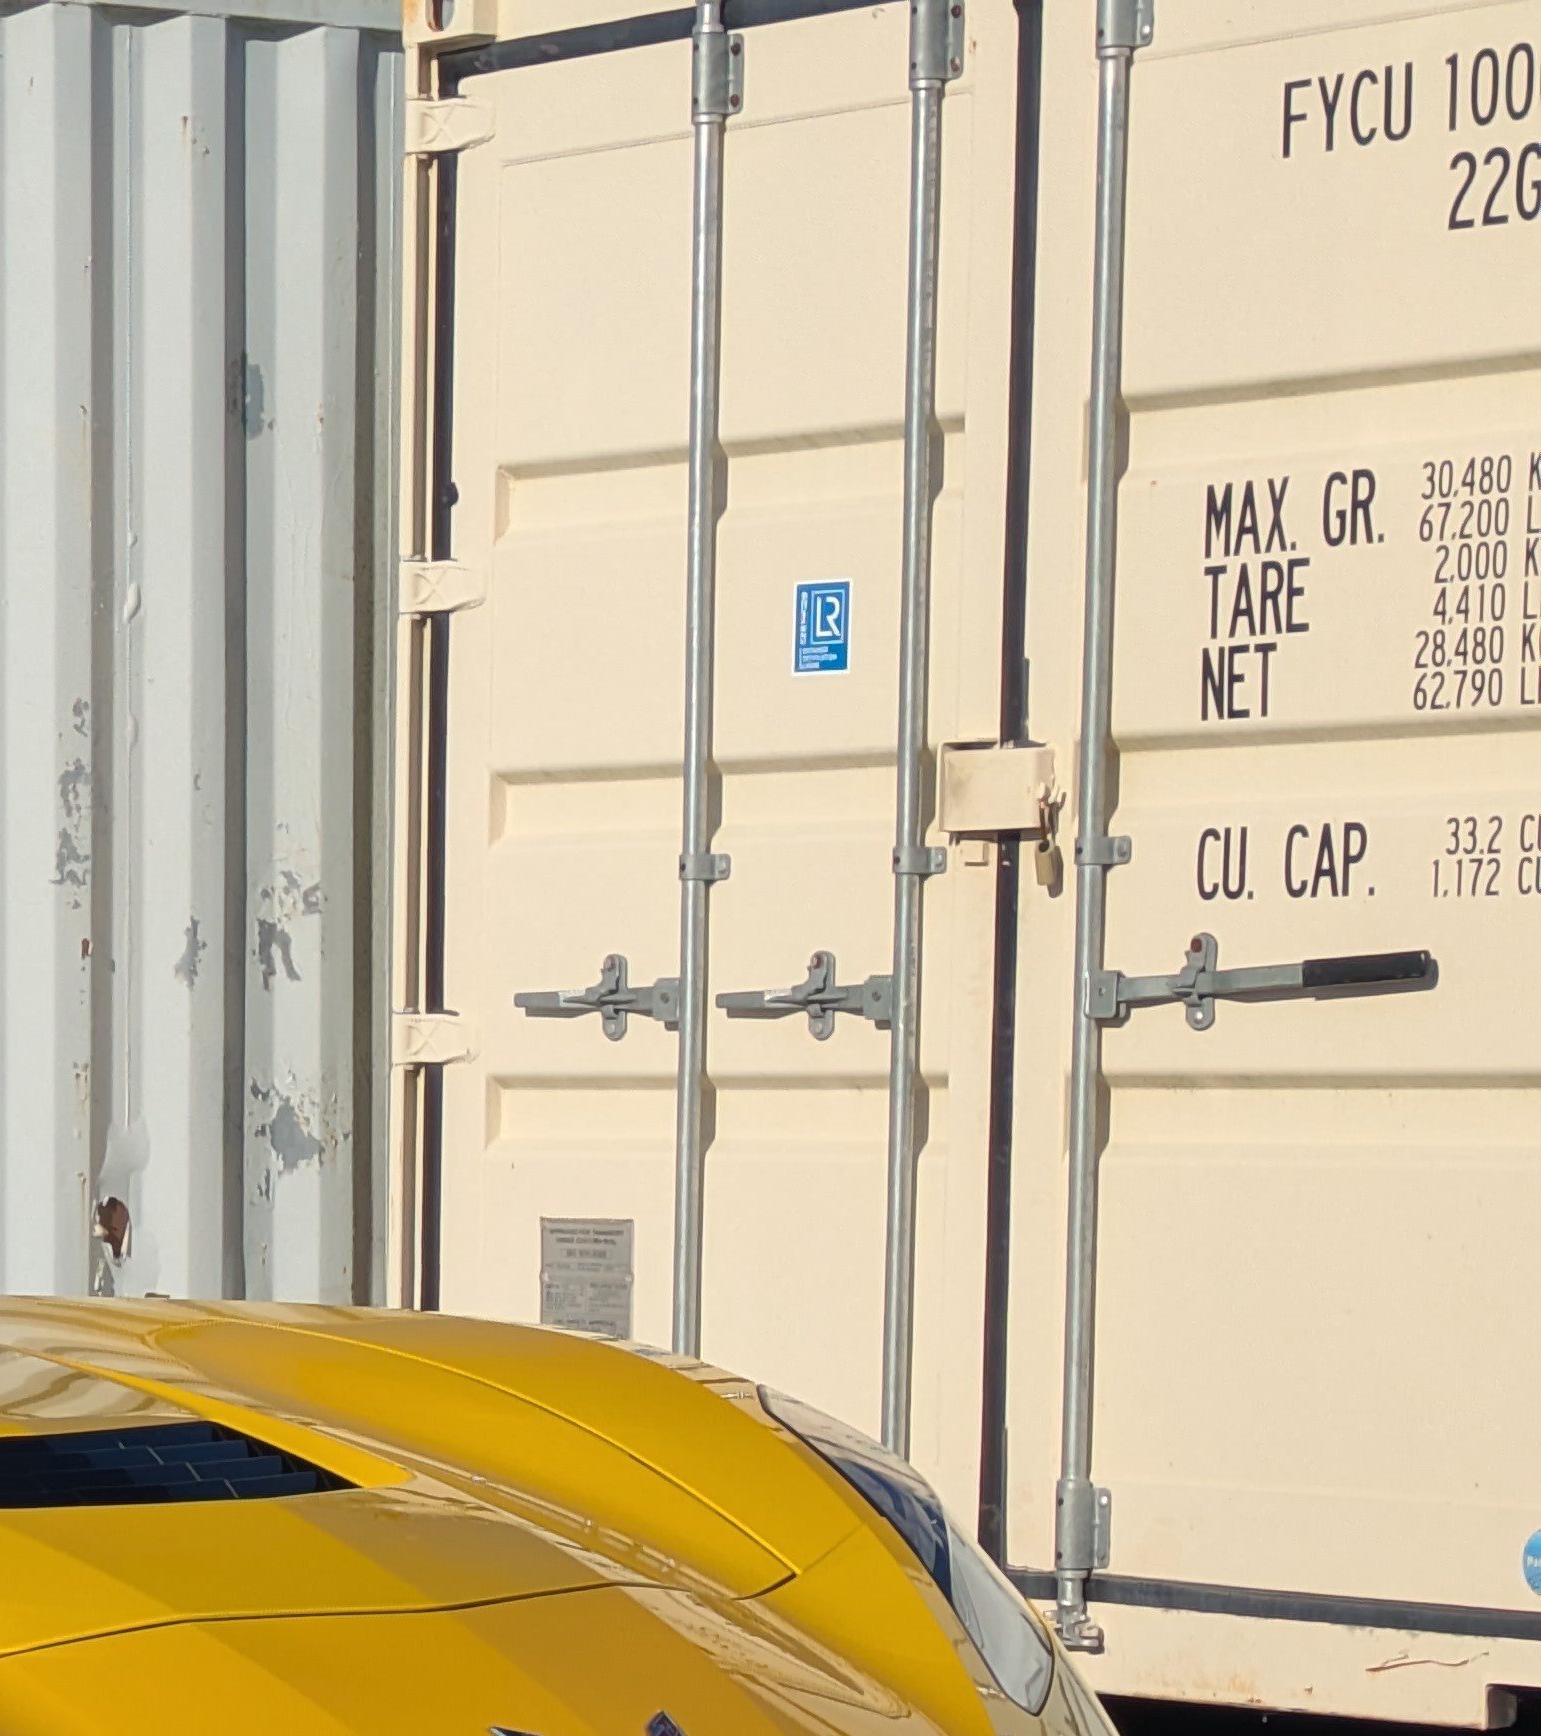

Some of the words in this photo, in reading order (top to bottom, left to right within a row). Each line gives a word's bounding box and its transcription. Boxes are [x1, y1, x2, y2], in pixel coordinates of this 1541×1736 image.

[1283, 61, 1413, 159] FYCU
[1445, 42, 1541, 131] 100
[1448, 142, 1541, 230] 22G
[1204, 475, 1297, 559] MAX.
[1322, 468, 1385, 547] GR.
[1420, 454, 1512, 500] 30,480
[1418, 497, 1510, 542] 67,200
[1203, 557, 1311, 640] TARE
[1433, 540, 1508, 583] 2,000
[1432, 582, 1506, 625] 4,410
[1522, 580, 1541, 620] L
[1201, 642, 1278, 721] NET
[1414, 625, 1504, 669] 28,480
[1520, 622, 1541, 663] K
[1412, 668, 1504, 711] 62,790
[1519, 666, 1541, 706] L
[1196, 826, 1255, 901] CU.
[1284, 821, 1376, 899] CAP.
[1445, 815, 1504, 856] 33.2
[1519, 813, 1541, 853] C
[1431, 857, 1502, 899] 1,172
